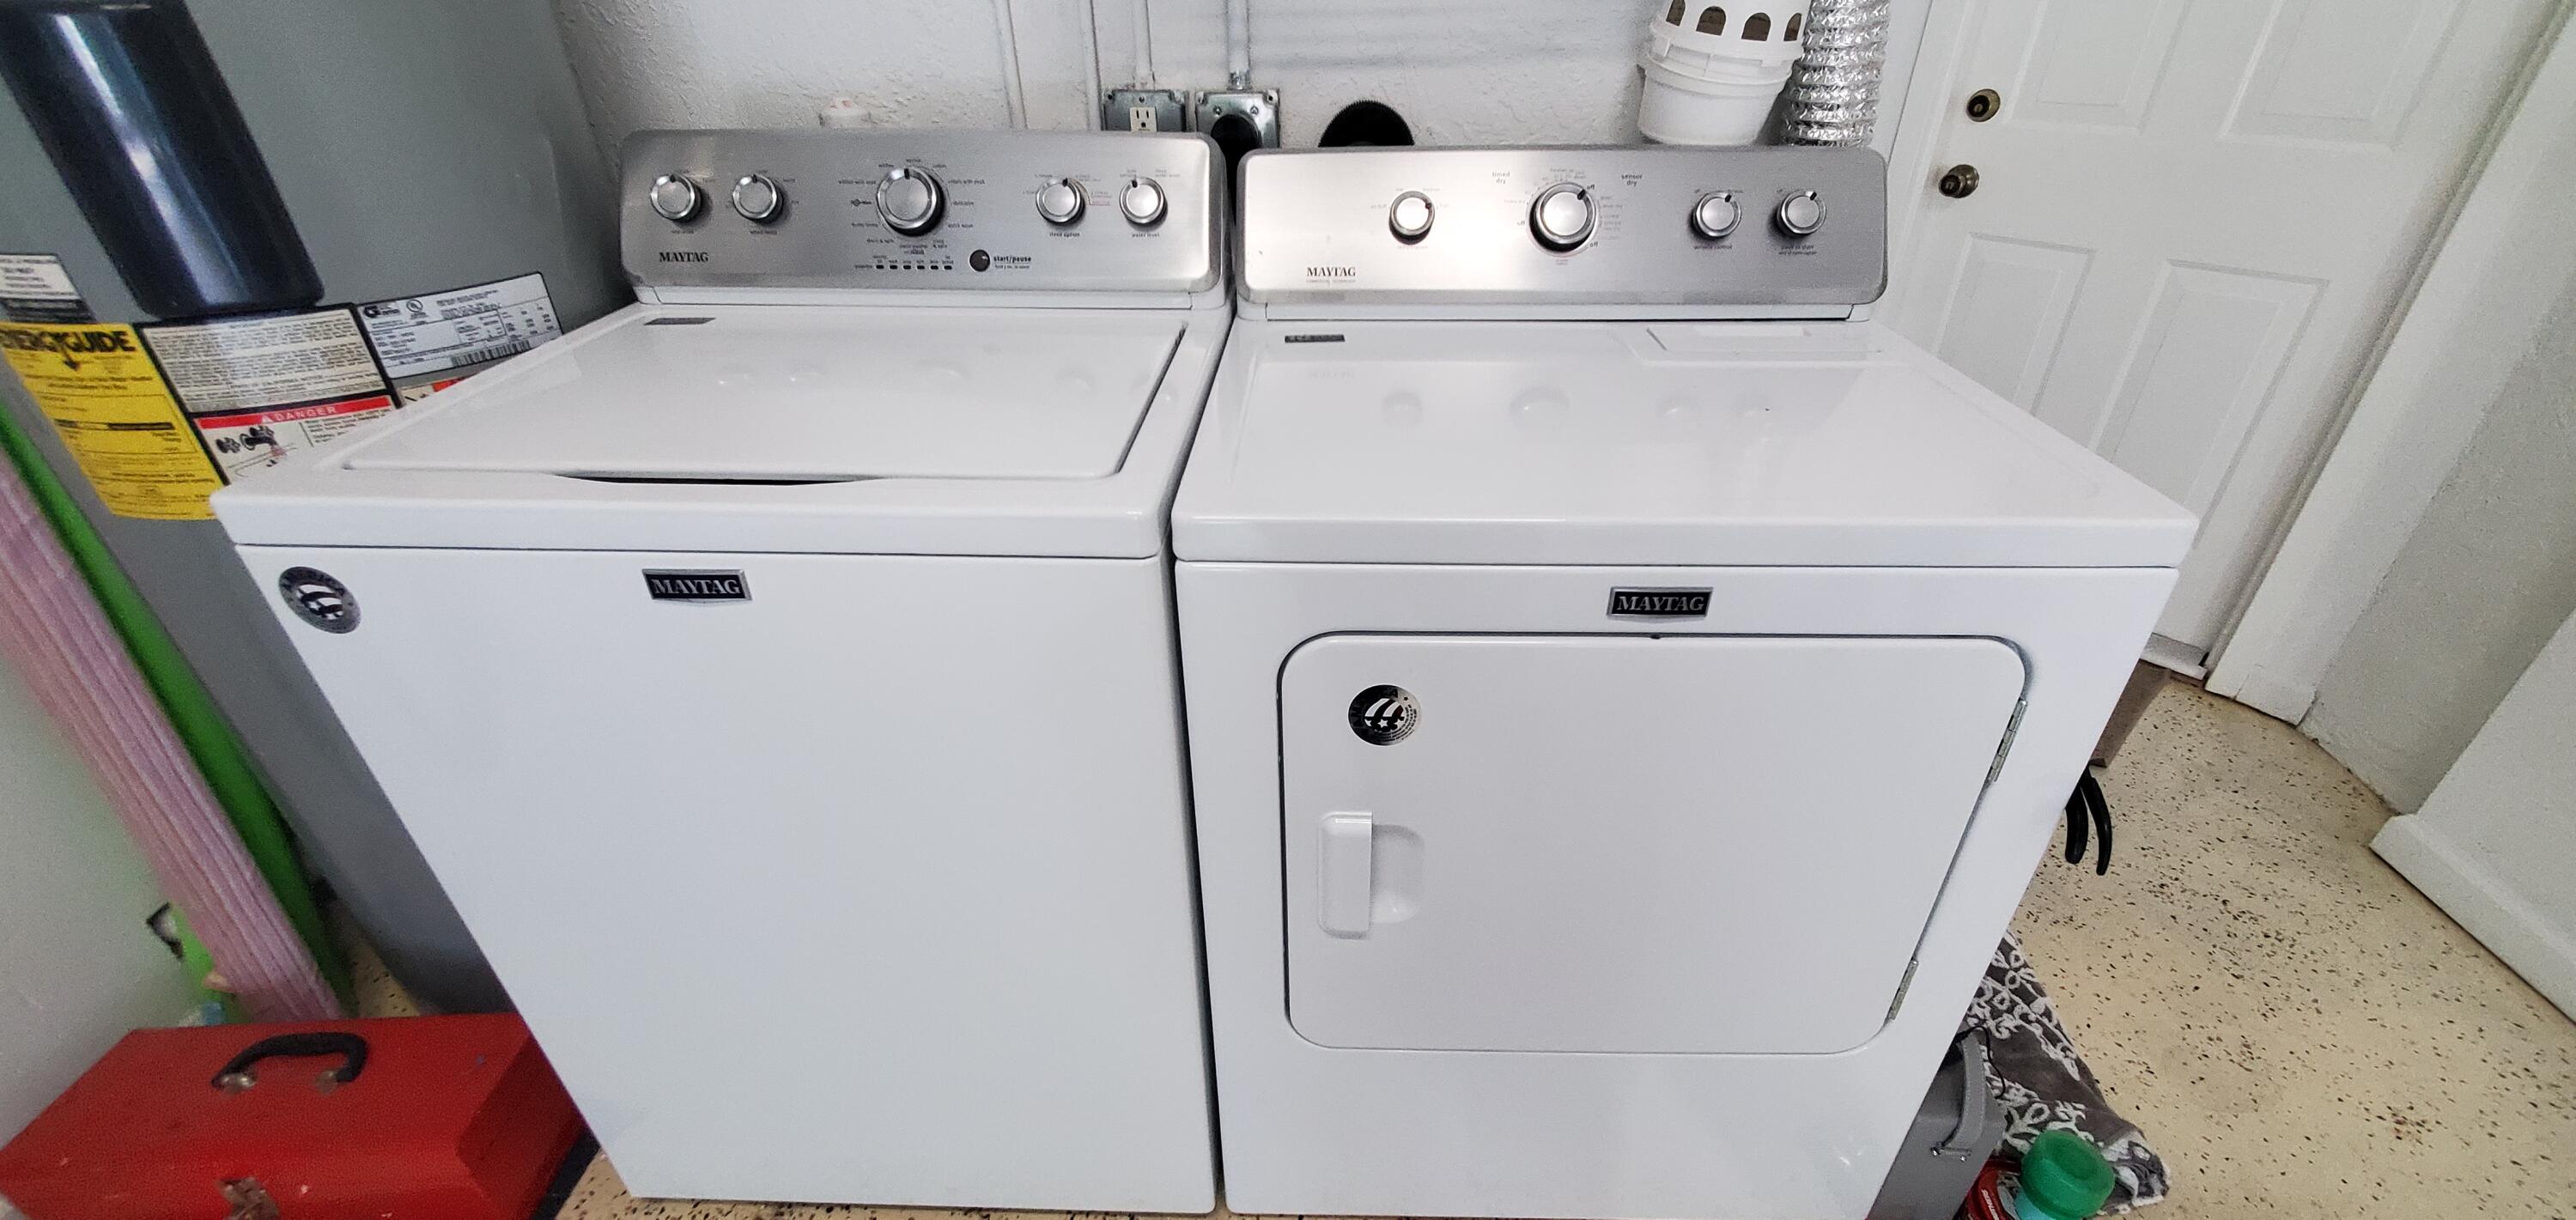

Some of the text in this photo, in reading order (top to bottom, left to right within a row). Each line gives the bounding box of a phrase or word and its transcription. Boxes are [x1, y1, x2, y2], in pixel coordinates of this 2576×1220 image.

[1626, 179, 1637, 187] dry
[659, 252, 709, 263] MAYTAG
[993, 255, 1032, 264] start/pause
[1306, 266, 1356, 276] MAYTAG
[275, 405, 338, 422] DANGER
[651, 579, 741, 594] MAYTAG
[1616, 596, 1705, 611] MAYTAG
